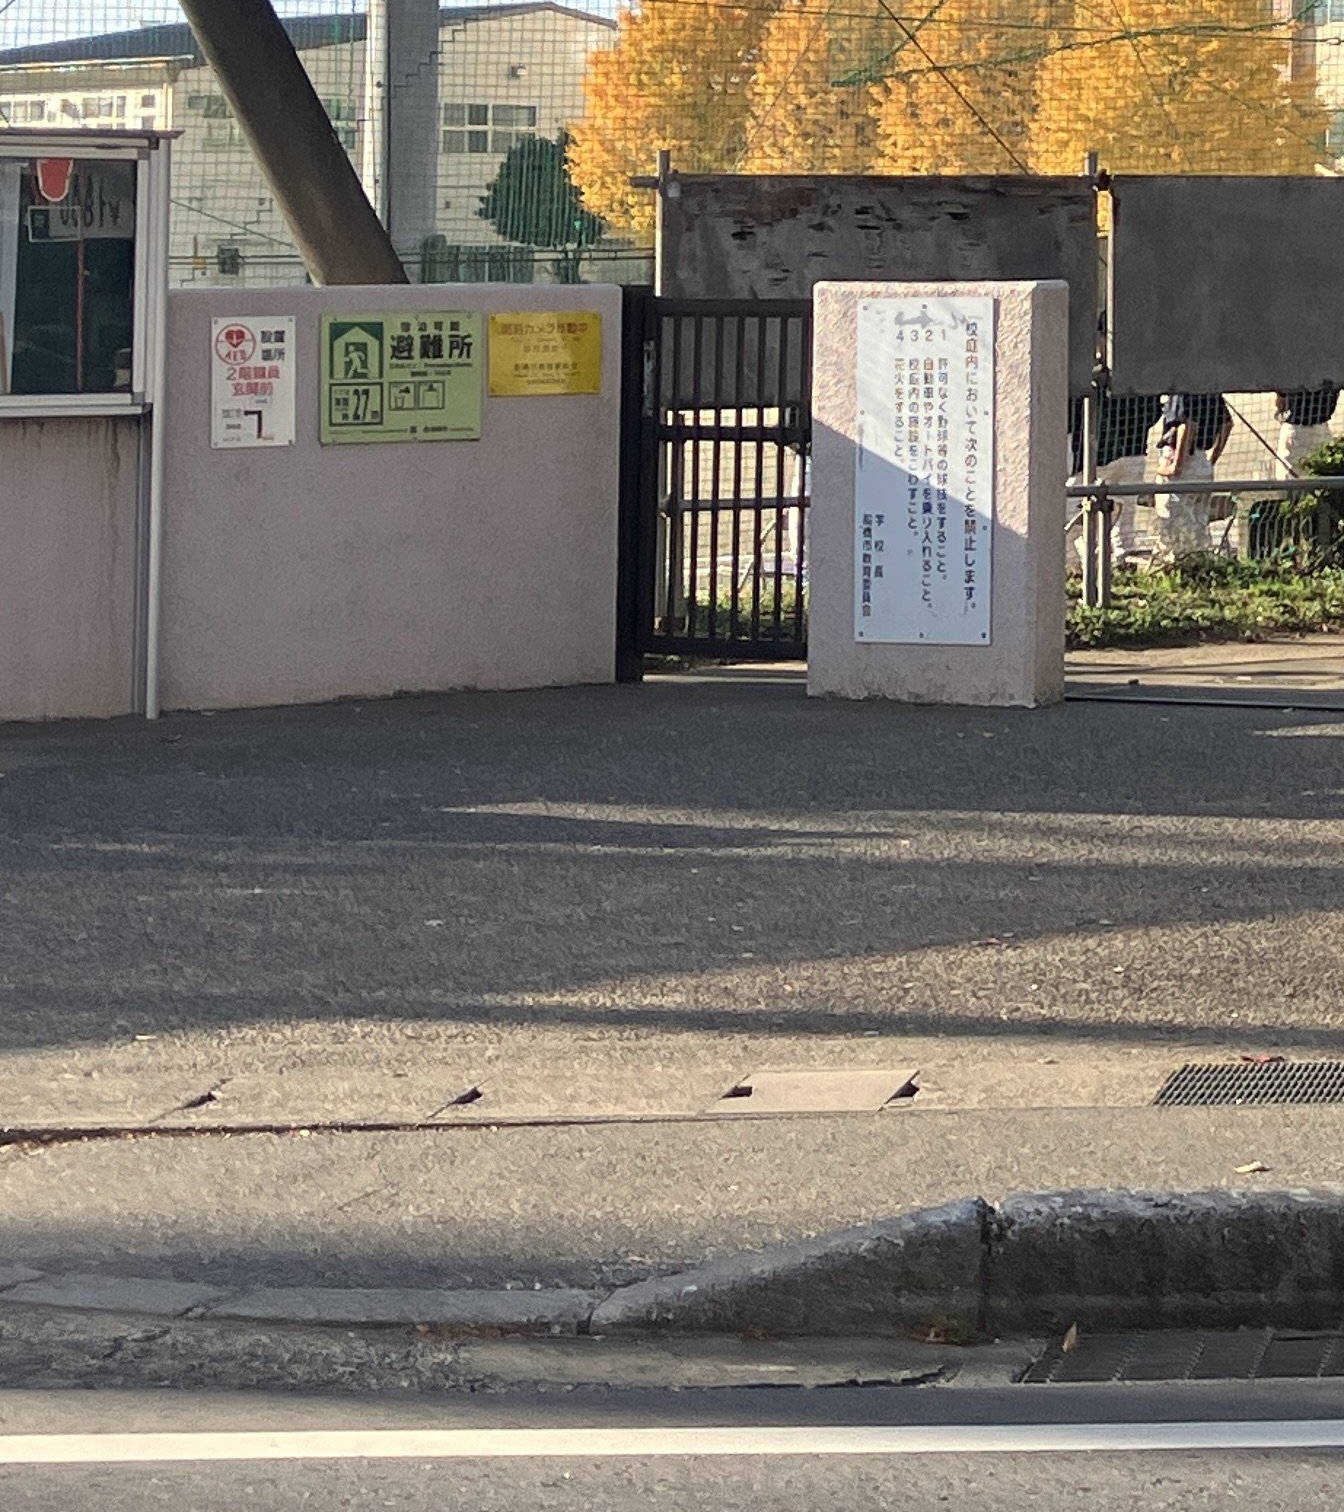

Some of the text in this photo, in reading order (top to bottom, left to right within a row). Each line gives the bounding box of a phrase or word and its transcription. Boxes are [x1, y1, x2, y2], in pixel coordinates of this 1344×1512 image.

[390, 334, 473, 360] 避難所
[352, 388, 370, 421] 27
